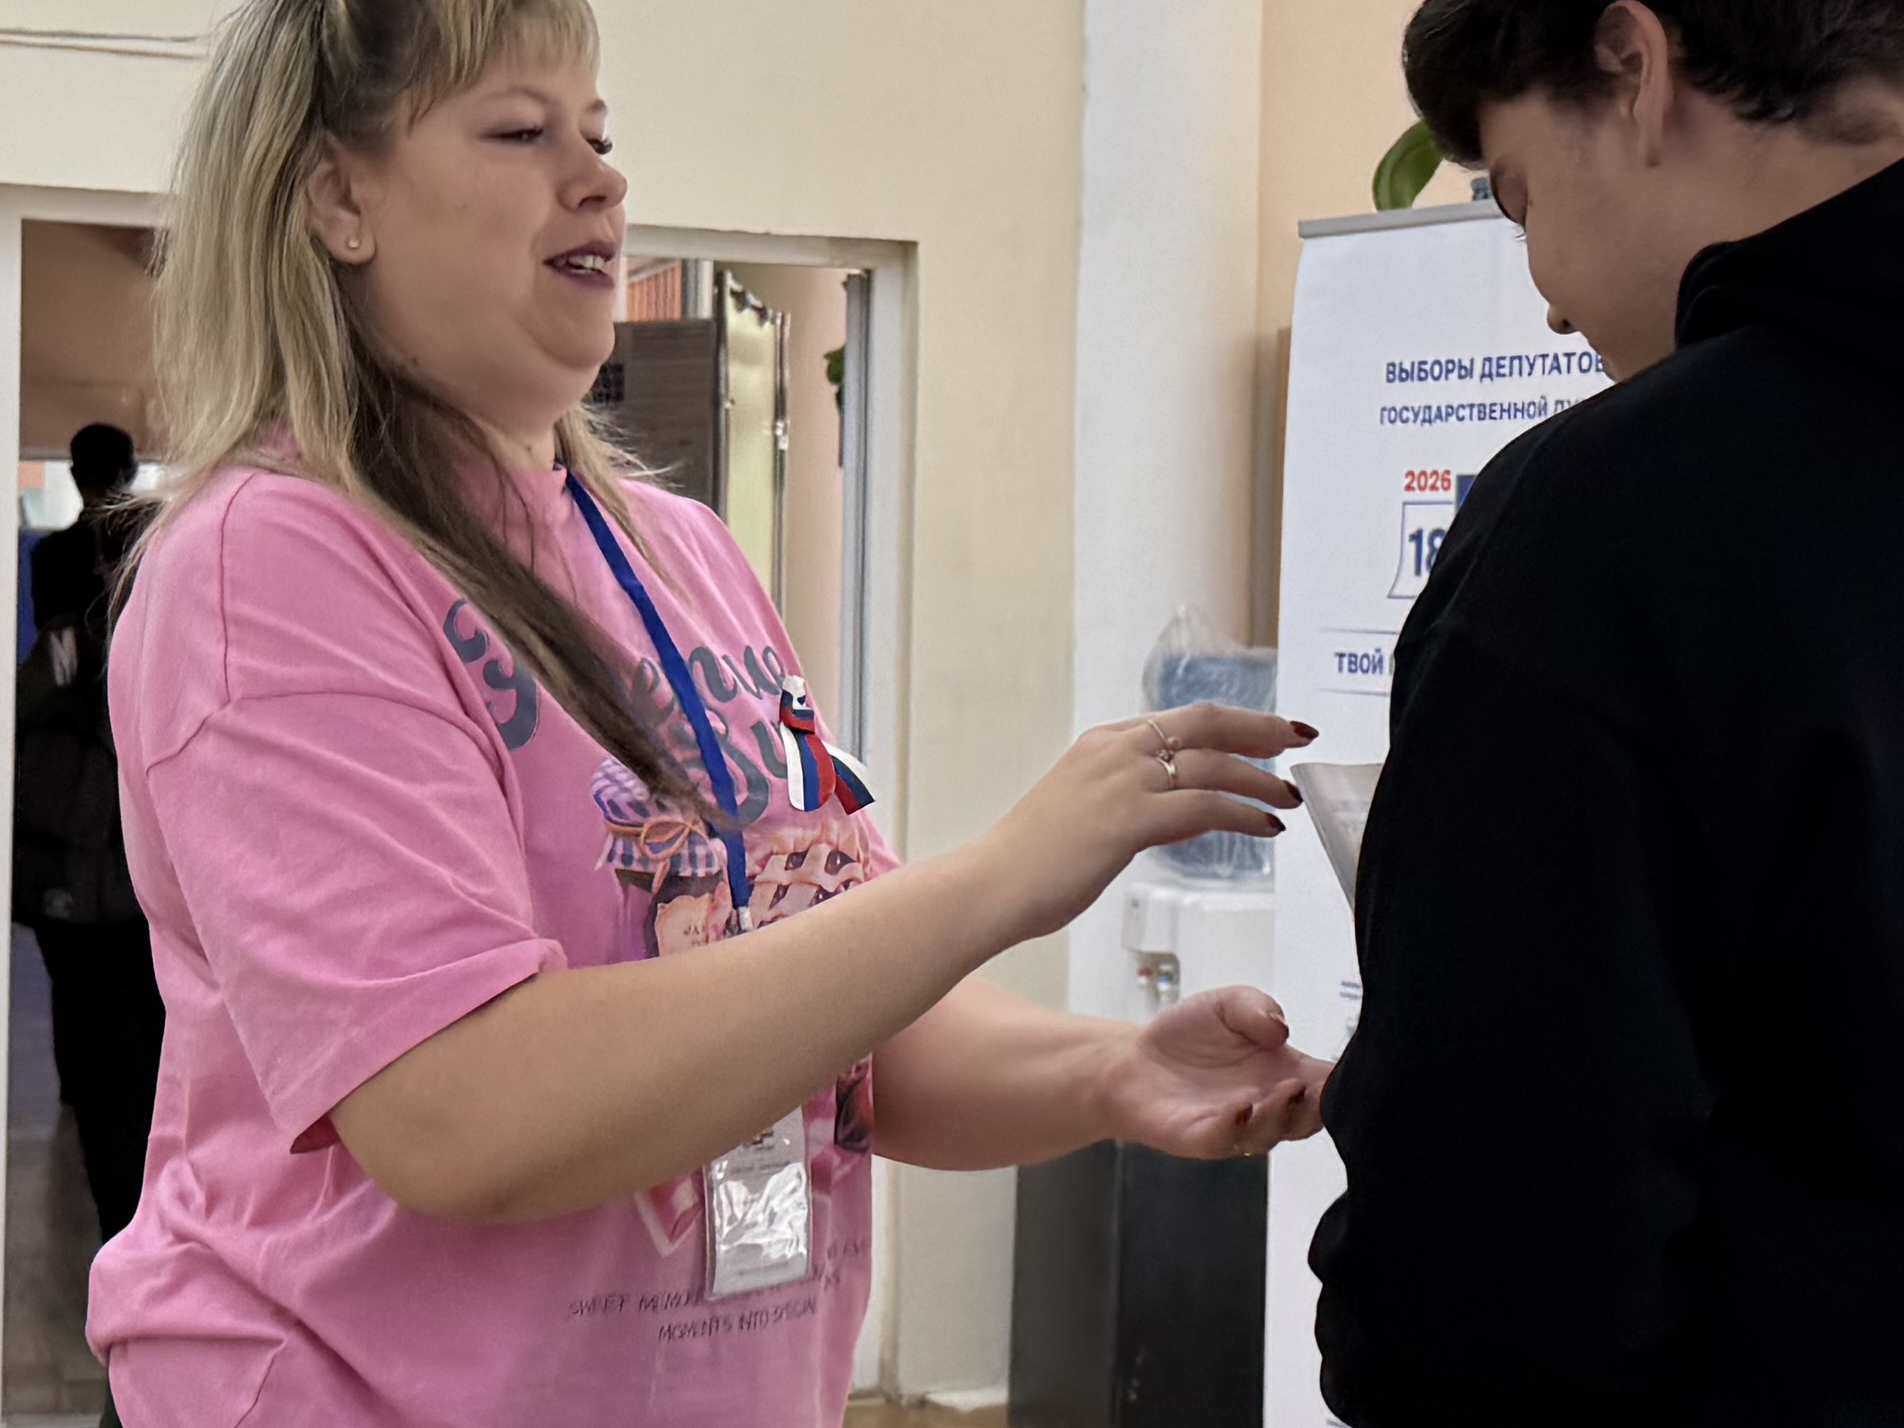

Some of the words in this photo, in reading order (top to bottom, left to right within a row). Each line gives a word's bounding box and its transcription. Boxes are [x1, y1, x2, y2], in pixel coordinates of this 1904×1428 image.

[1385, 358, 1474, 383] ВЫБОРЫ
[1479, 351, 1605, 382] ДЕПУТАТОВ
[1380, 395, 1548, 427] ГОСУДАРСТВЕННОЙ
[1403, 469, 1452, 492] 2026
[1334, 648, 1384, 675] ТВОЙ
